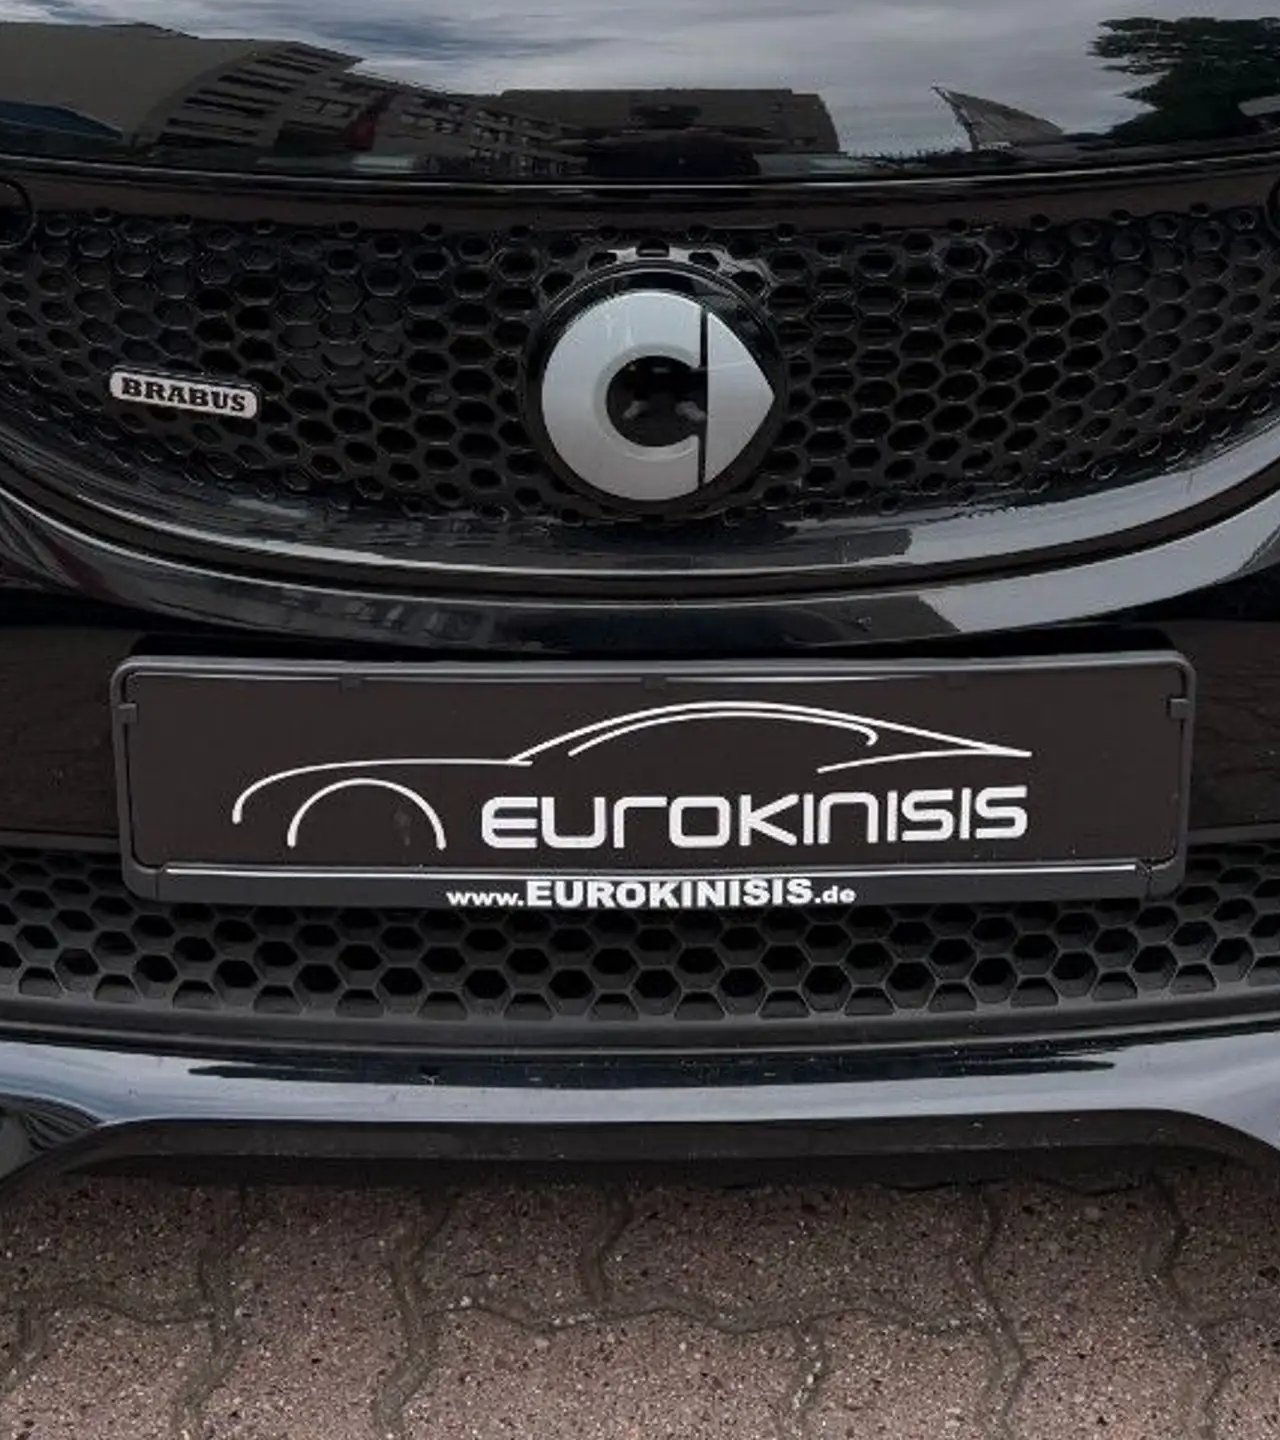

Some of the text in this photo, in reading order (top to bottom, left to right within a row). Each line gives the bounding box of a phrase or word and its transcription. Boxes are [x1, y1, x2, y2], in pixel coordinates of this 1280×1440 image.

[120, 377, 247, 412] BRABUS
[481, 785, 1028, 849] EUROKINISIS
[446, 878, 857, 909] www.EUROKINISIS.de
